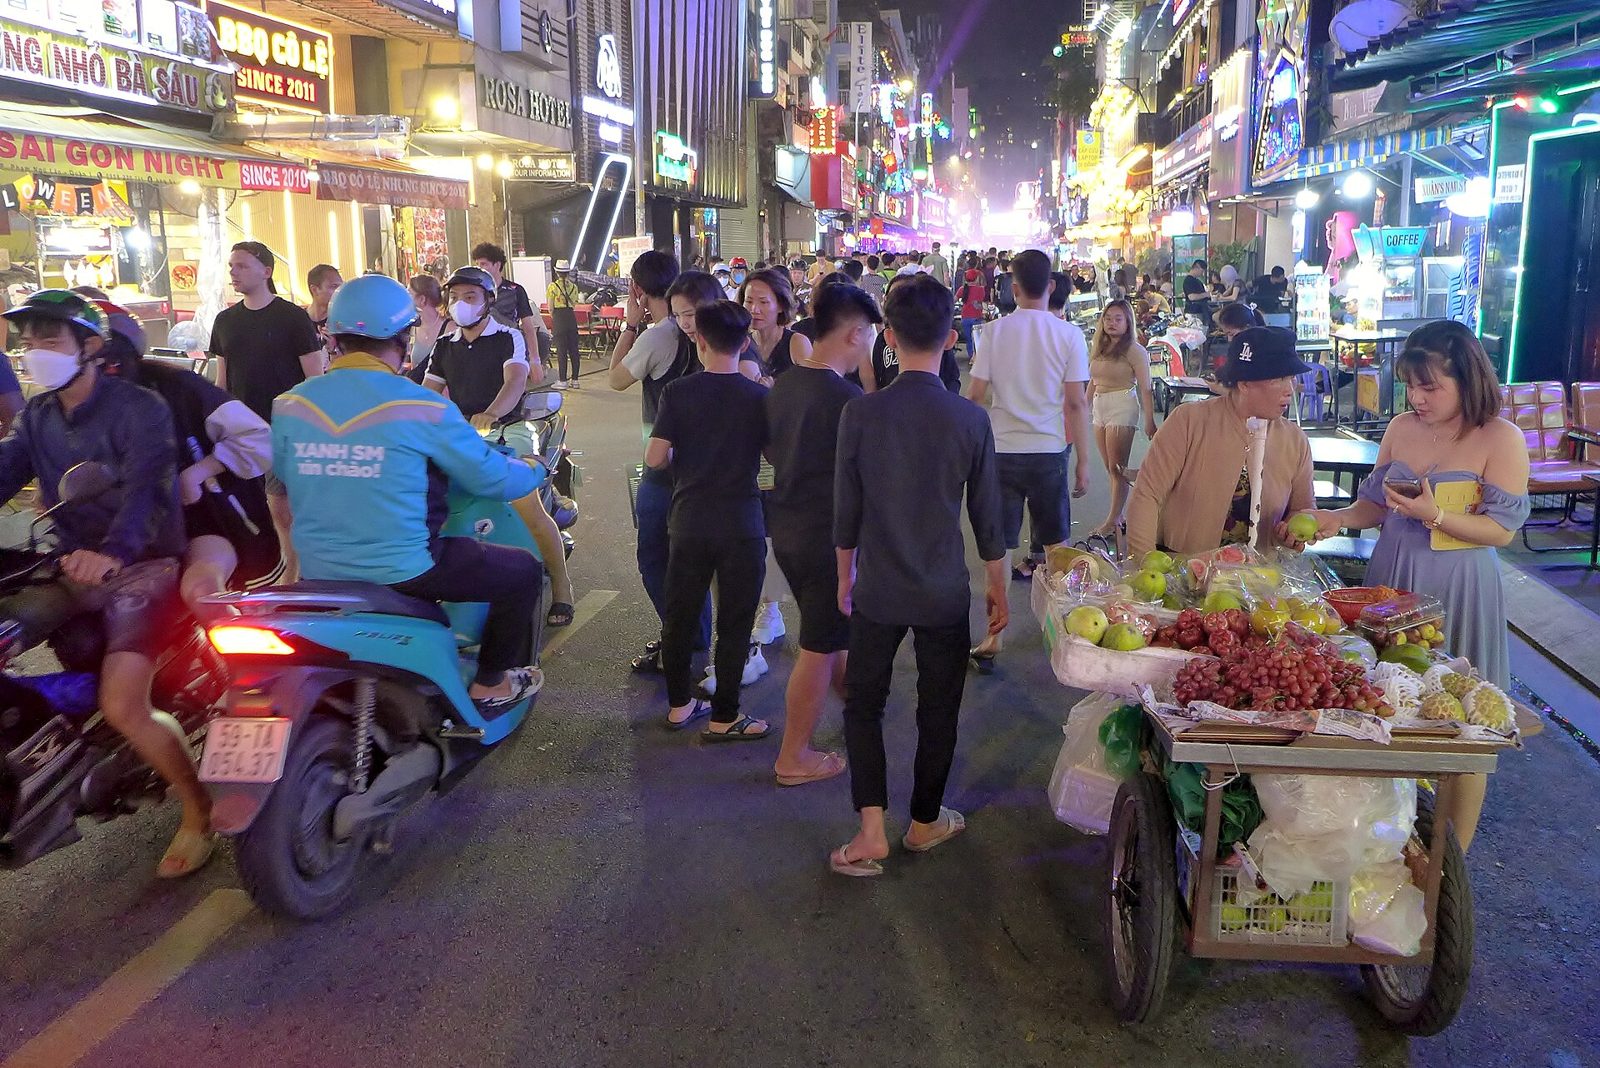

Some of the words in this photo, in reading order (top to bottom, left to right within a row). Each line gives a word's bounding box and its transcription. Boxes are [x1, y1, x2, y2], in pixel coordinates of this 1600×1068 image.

[218, 16, 269, 66] BBQ
[272, 31, 300, 68] CÔ
[237, 67, 284, 95] SINCE
[286, 77, 315, 102] 2011
[482, 77, 526, 118] ROSA
[529, 89, 572, 129] HOTEL
[0, 131, 55, 163] SAI
[66, 140, 134, 171] GON
[143, 149, 225, 179] NIGHT
[242, 164, 281, 187] SINCE
[282, 168, 309, 188] 2010
[350, 171, 364, 187] CÔ
[421, 181, 448, 196] SINCE
[1386, 234, 1419, 247] COFFEE
[1239, 343, 1252, 361] LA
[294, 442, 348, 459] XANH
[352, 445, 385, 461] SM
[298, 460, 322, 475] xin
